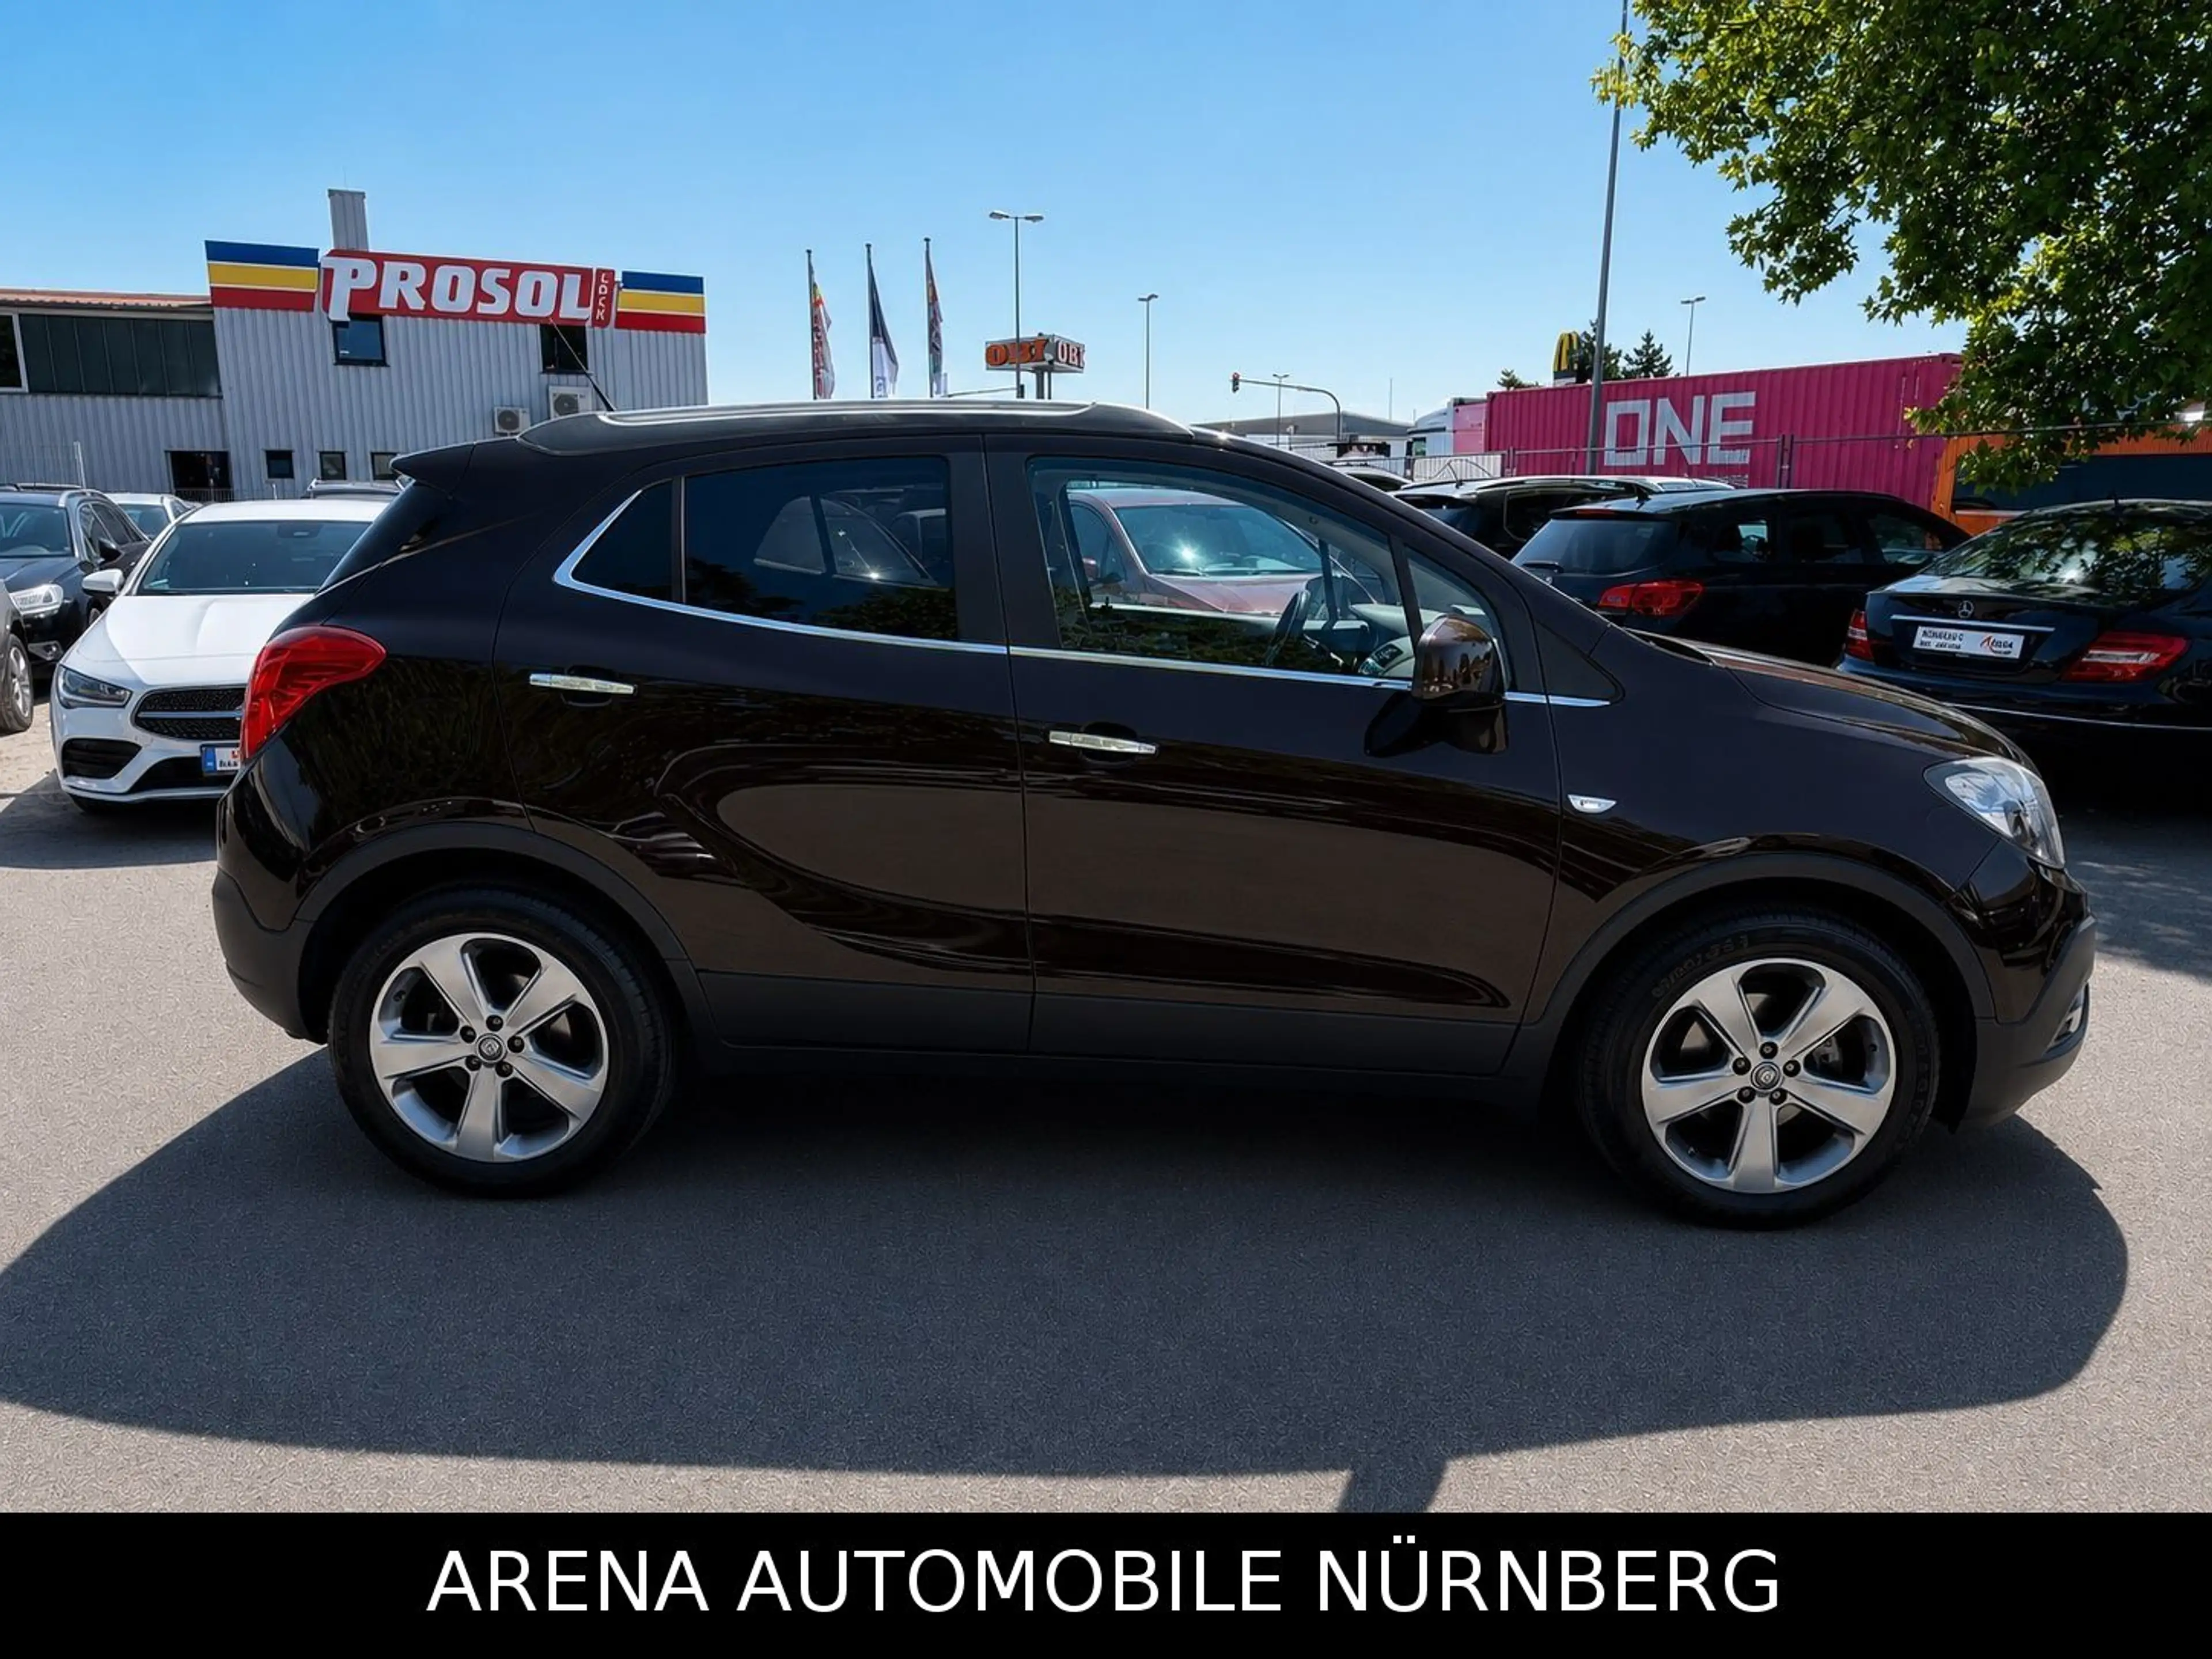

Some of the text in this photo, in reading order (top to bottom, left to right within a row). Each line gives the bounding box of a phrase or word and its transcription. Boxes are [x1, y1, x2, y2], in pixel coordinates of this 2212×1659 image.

[321, 256, 590, 320] PROSOL
[595, 272, 609, 321] LOCK
[1057, 339, 1085, 368] OBI
[1604, 391, 1756, 466] ONE
